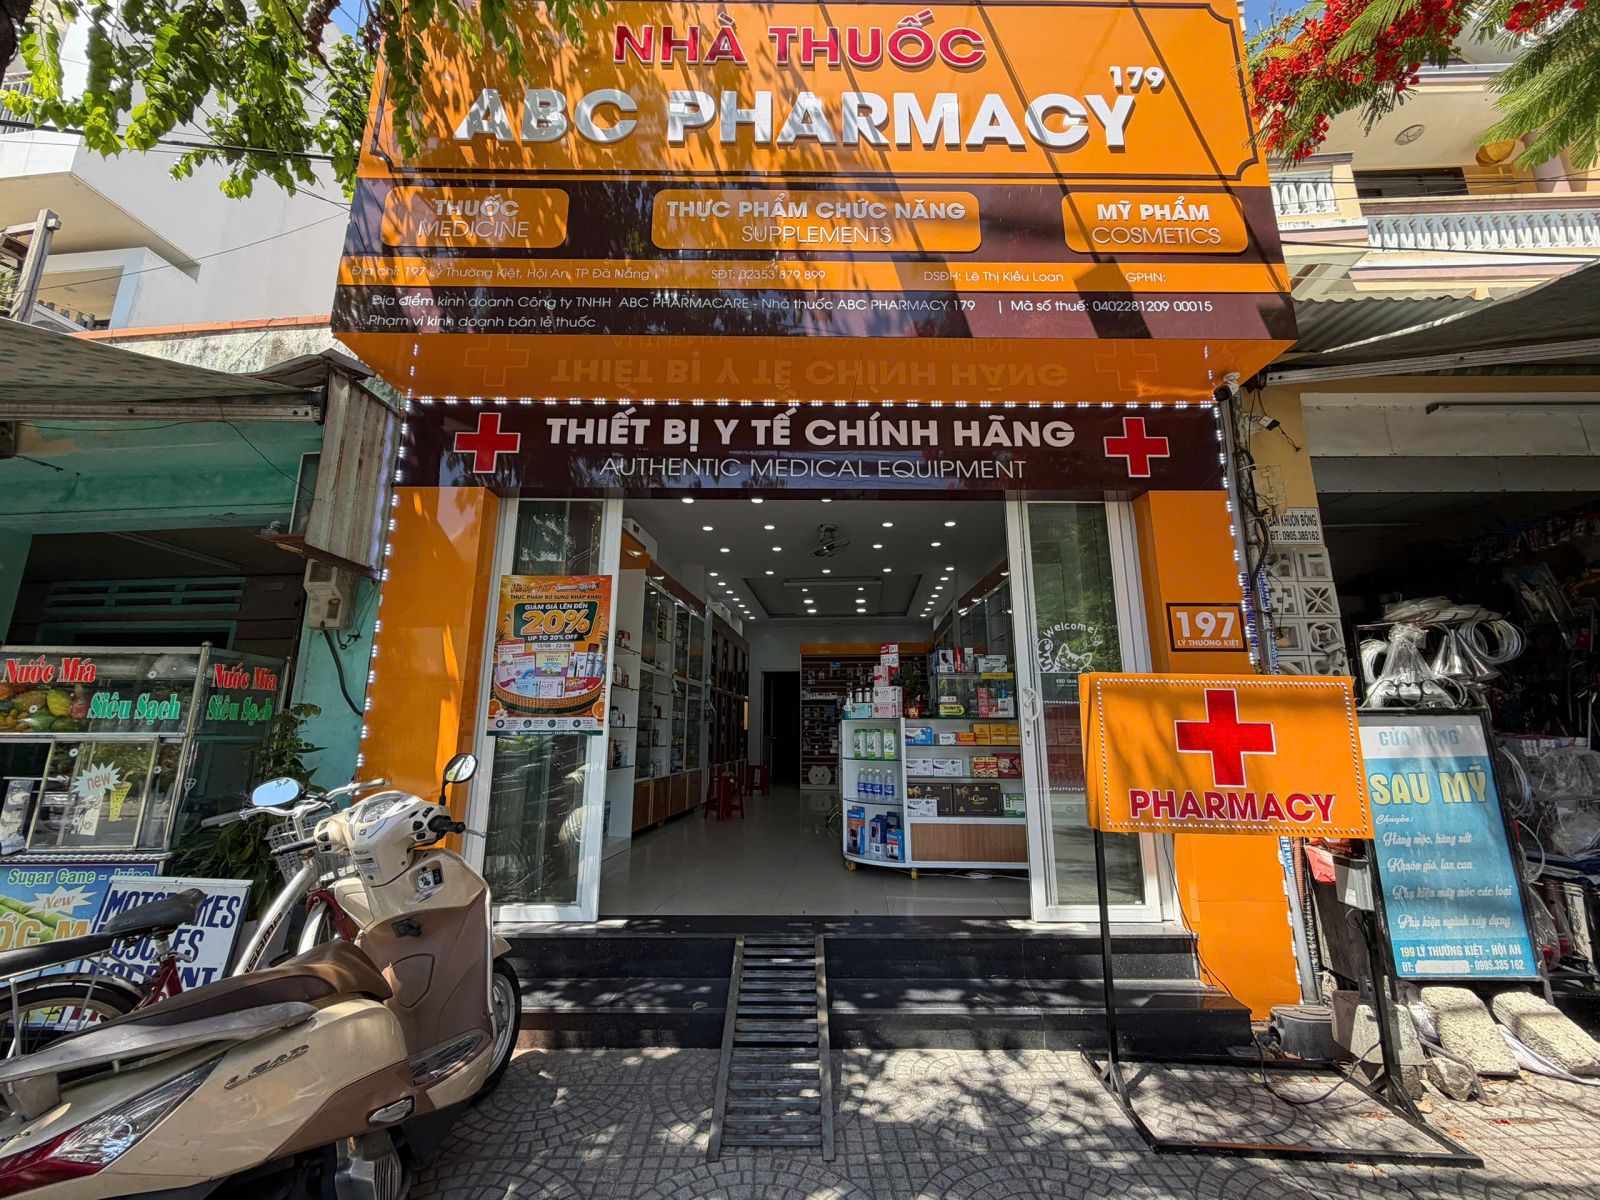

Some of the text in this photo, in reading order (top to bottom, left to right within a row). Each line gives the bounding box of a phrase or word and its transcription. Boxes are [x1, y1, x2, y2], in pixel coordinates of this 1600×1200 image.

[613, 9, 986, 67] NHÀ THUỐC
[452, 66, 1165, 148] ABC PHARMACY 179
[434, 194, 520, 217] THUỐC
[667, 193, 966, 222] THỰC PHẨM CHỨC NĂNG
[1096, 196, 1210, 221] MỸ PHẨM
[418, 220, 530, 239] MEDICINE
[741, 226, 893, 244] SUPPLEMENTS
[1092, 227, 1221, 245] COSMETICS
[405, 267, 425, 277] 197
[429, 266, 443, 279] Lý
[447, 266, 493, 279] Thường
[527, 267, 548, 279] Hội
[575, 268, 589, 278] TP
[592, 267, 611, 279] Đà
[614, 266, 650, 281] Nẵng
[711, 269, 826, 281] SĐT: 02353 879 899
[924, 269, 1064, 283] DSĐH: Lê Thị Kiều Loan
[1125, 272, 1167, 283] GPHN:
[372, 292, 976, 311] Địa điểm kinh doanh Công ty TNHH ABC PHARMACARE Nhà thuốc ABC PHARMACY 179
[1010, 298, 1213, 312] Mã số thuế: 0402281209 00015
[368, 315, 596, 329] Phạm vi kinh doanh bán lẻ thuốc
[546, 407, 1075, 452] THIẾT BỊ Y TẾ CHÍNH HÃNG
[599, 457, 1026, 479] AUTHENTIC MEDICAL EQUIPMENT
[524, 602, 544, 611] GIẢM
[545, 602, 558, 610] GIÁ
[559, 602, 573, 610] LÊN
[521, 608, 591, 635] 20%
[1175, 611, 1235, 638] 197
[1177, 638, 1241, 647] LÝ THƯỜNG KIỆT
[0, 655, 97, 684] Nước Mía
[211, 661, 277, 691] Nước Mía
[87, 692, 181, 725] Siêu Sạch
[206, 694, 272, 726] Siêu Sạch
[1379, 728, 1410, 746] CỬA
[86, 772, 111, 790] new
[1369, 763, 1487, 805] SAU MỸ
[1128, 788, 1336, 824] PHARMACY
[1441, 858, 1455, 870] lan
[1456, 861, 1473, 870] can
[8, 868, 53, 888] Sugar
[56, 869, 97, 885] Cane
[1477, 887, 1494, 897] các
[1495, 884, 1513, 897] loại
[43, 894, 75, 910] New
[1399, 942, 1522, 959] 199 LÝ THƯỜNG KIỆT HỘI AN
[1402, 961, 1414, 972] ĐT:
[1510, 959, 1525, 970] 162
[223, 1044, 310, 1090] LEAD
